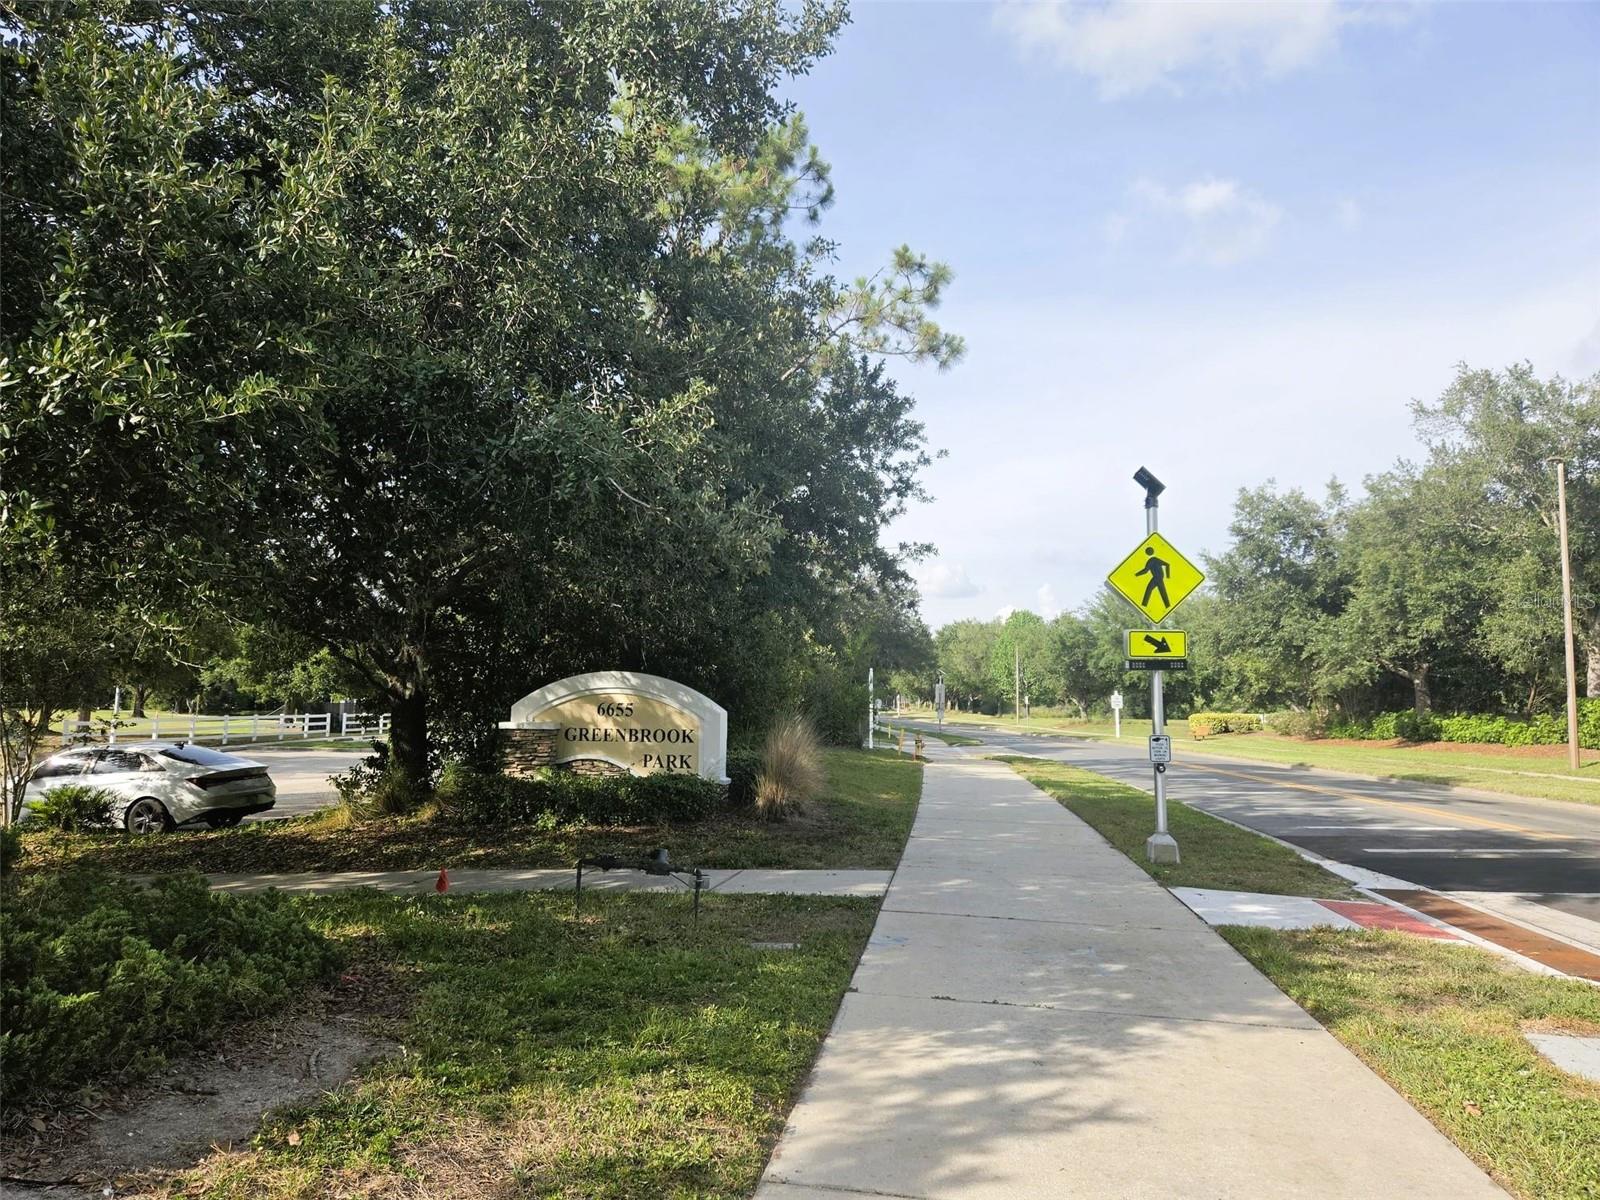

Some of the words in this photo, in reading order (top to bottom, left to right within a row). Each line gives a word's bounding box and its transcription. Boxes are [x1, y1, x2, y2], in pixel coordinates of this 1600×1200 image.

[596, 702, 634, 717] 6655
[564, 727, 695, 744] GREENBROOK
[642, 753, 692, 770] PARK
